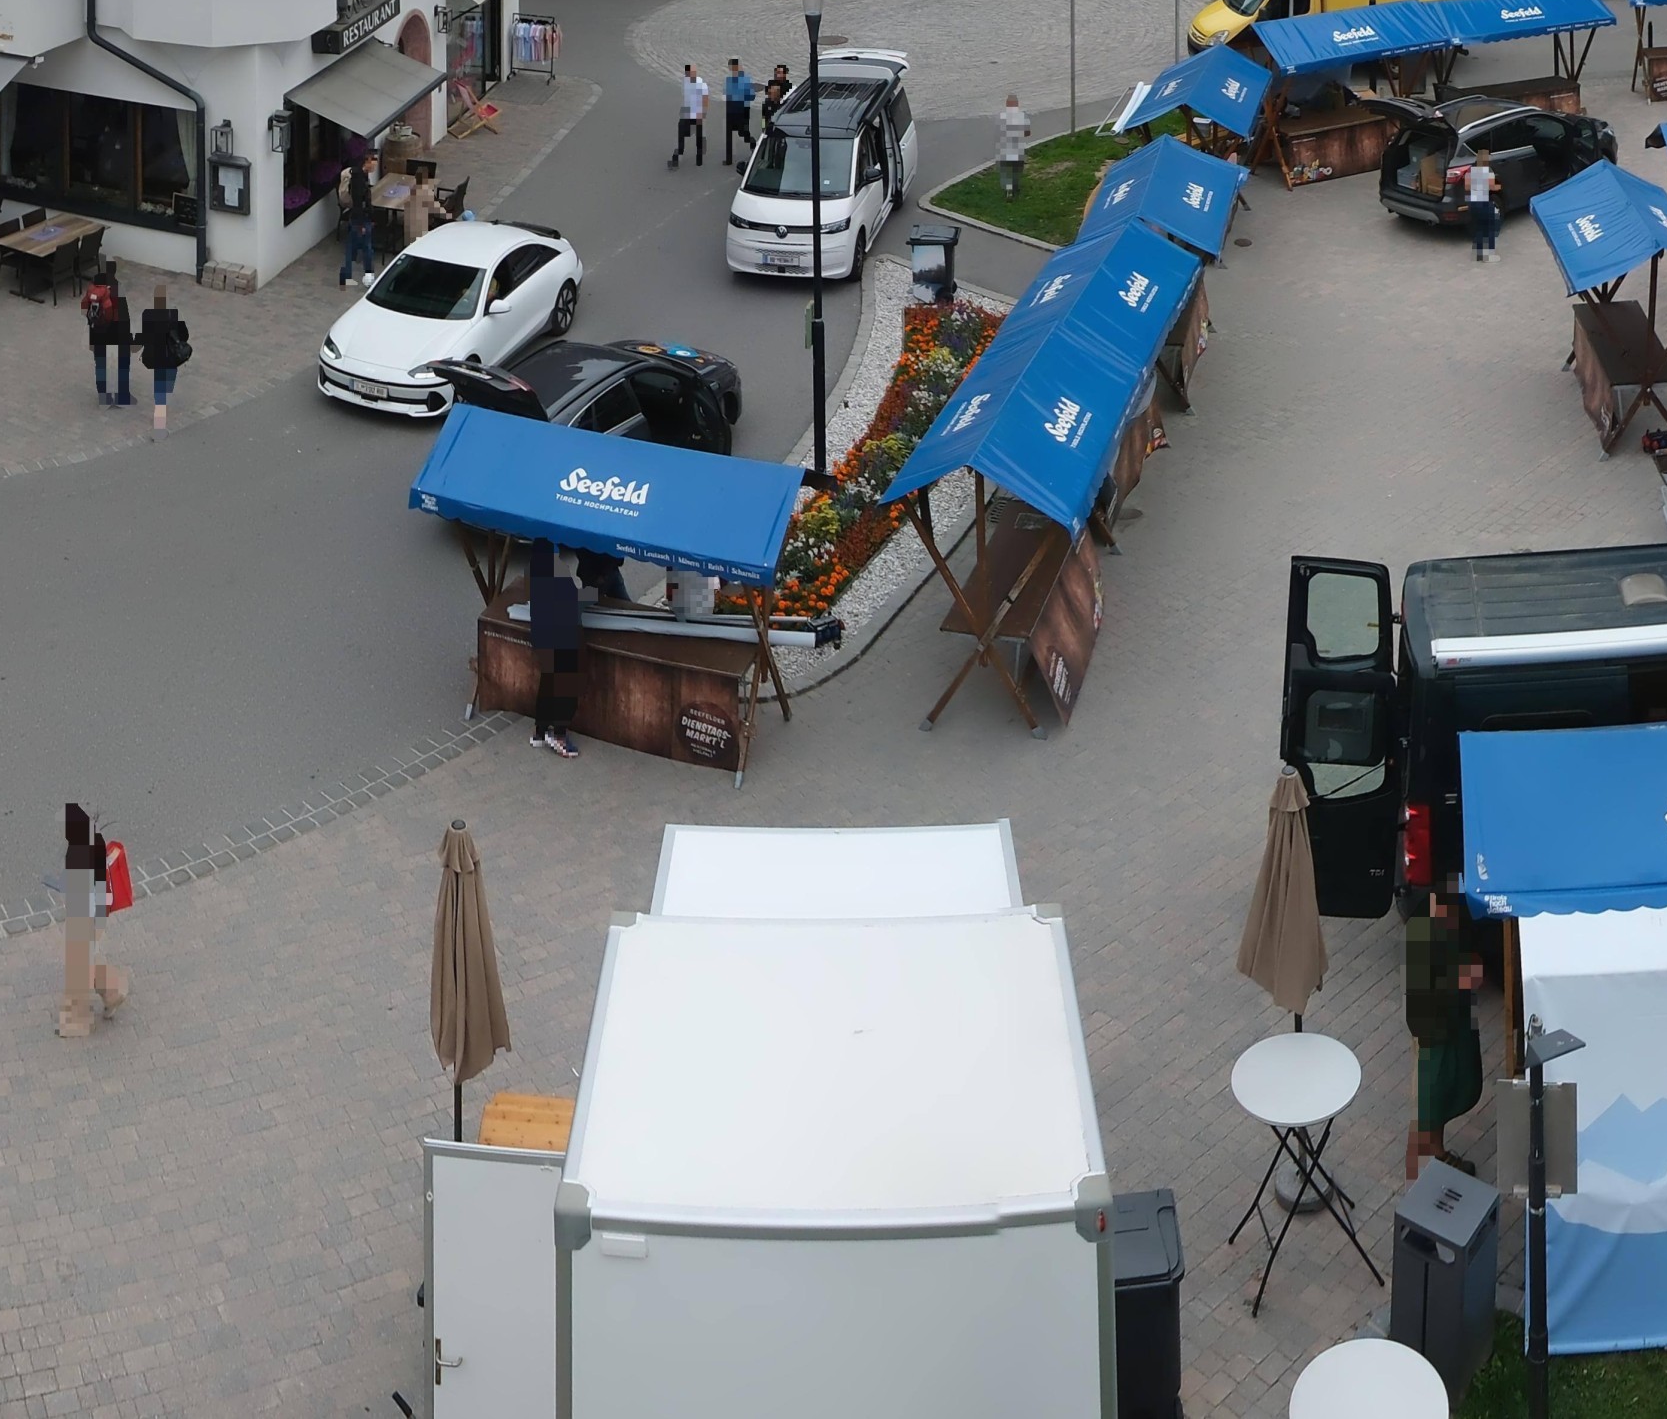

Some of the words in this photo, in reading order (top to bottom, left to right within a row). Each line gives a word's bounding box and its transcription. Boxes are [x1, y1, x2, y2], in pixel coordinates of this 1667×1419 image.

[343, 0, 396, 47] RESTAURANT
[1501, 6, 1543, 20] Seefeld
[1333, 25, 1376, 42] Seefeld
[1118, 270, 1150, 308] Seefeld
[1044, 396, 1082, 443] Seefeld
[559, 467, 650, 505] Seefeld
[556, 492, 582, 506] TIROLS
[584, 500, 640, 518] HOCHPLATEAU
[681, 715, 732, 738] DIENSTAGS-
